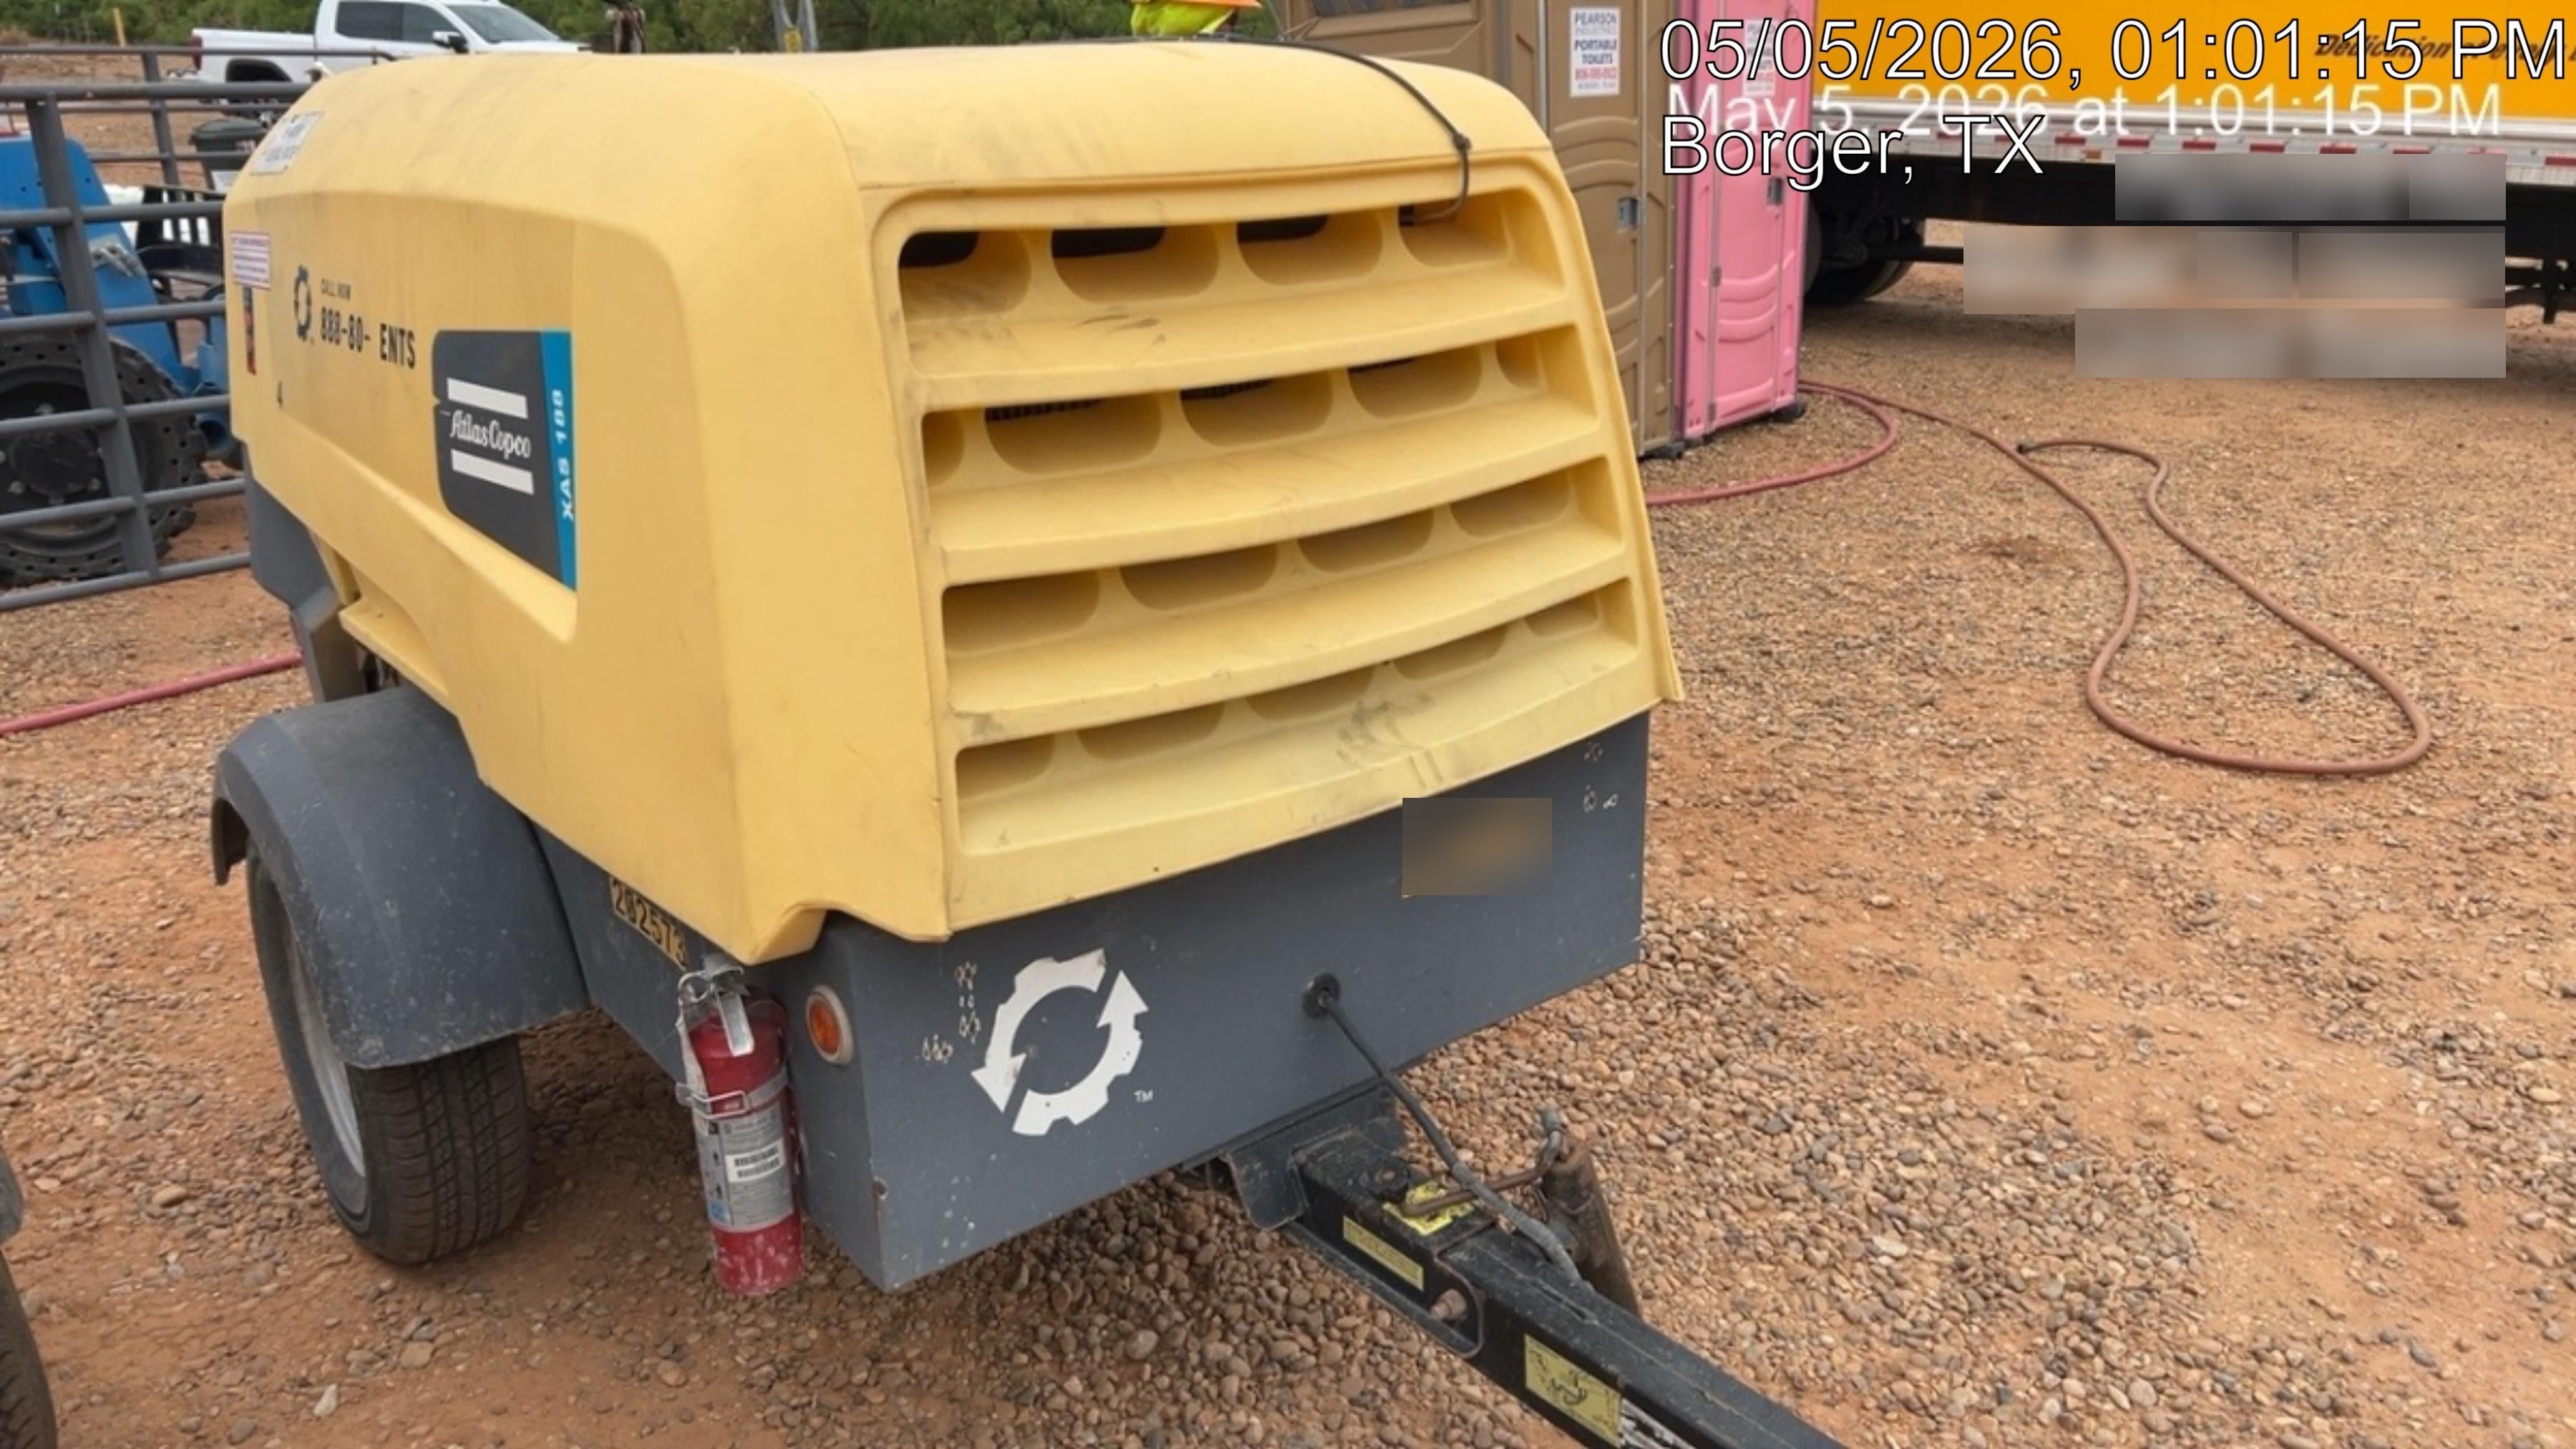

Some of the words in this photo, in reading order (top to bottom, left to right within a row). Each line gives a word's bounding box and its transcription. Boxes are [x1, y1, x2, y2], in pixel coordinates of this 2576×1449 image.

[1574, 12, 1616, 25] PEARSON
[1574, 39, 1617, 52] PORTABLE
[1581, 53, 1613, 65] TOILETS
